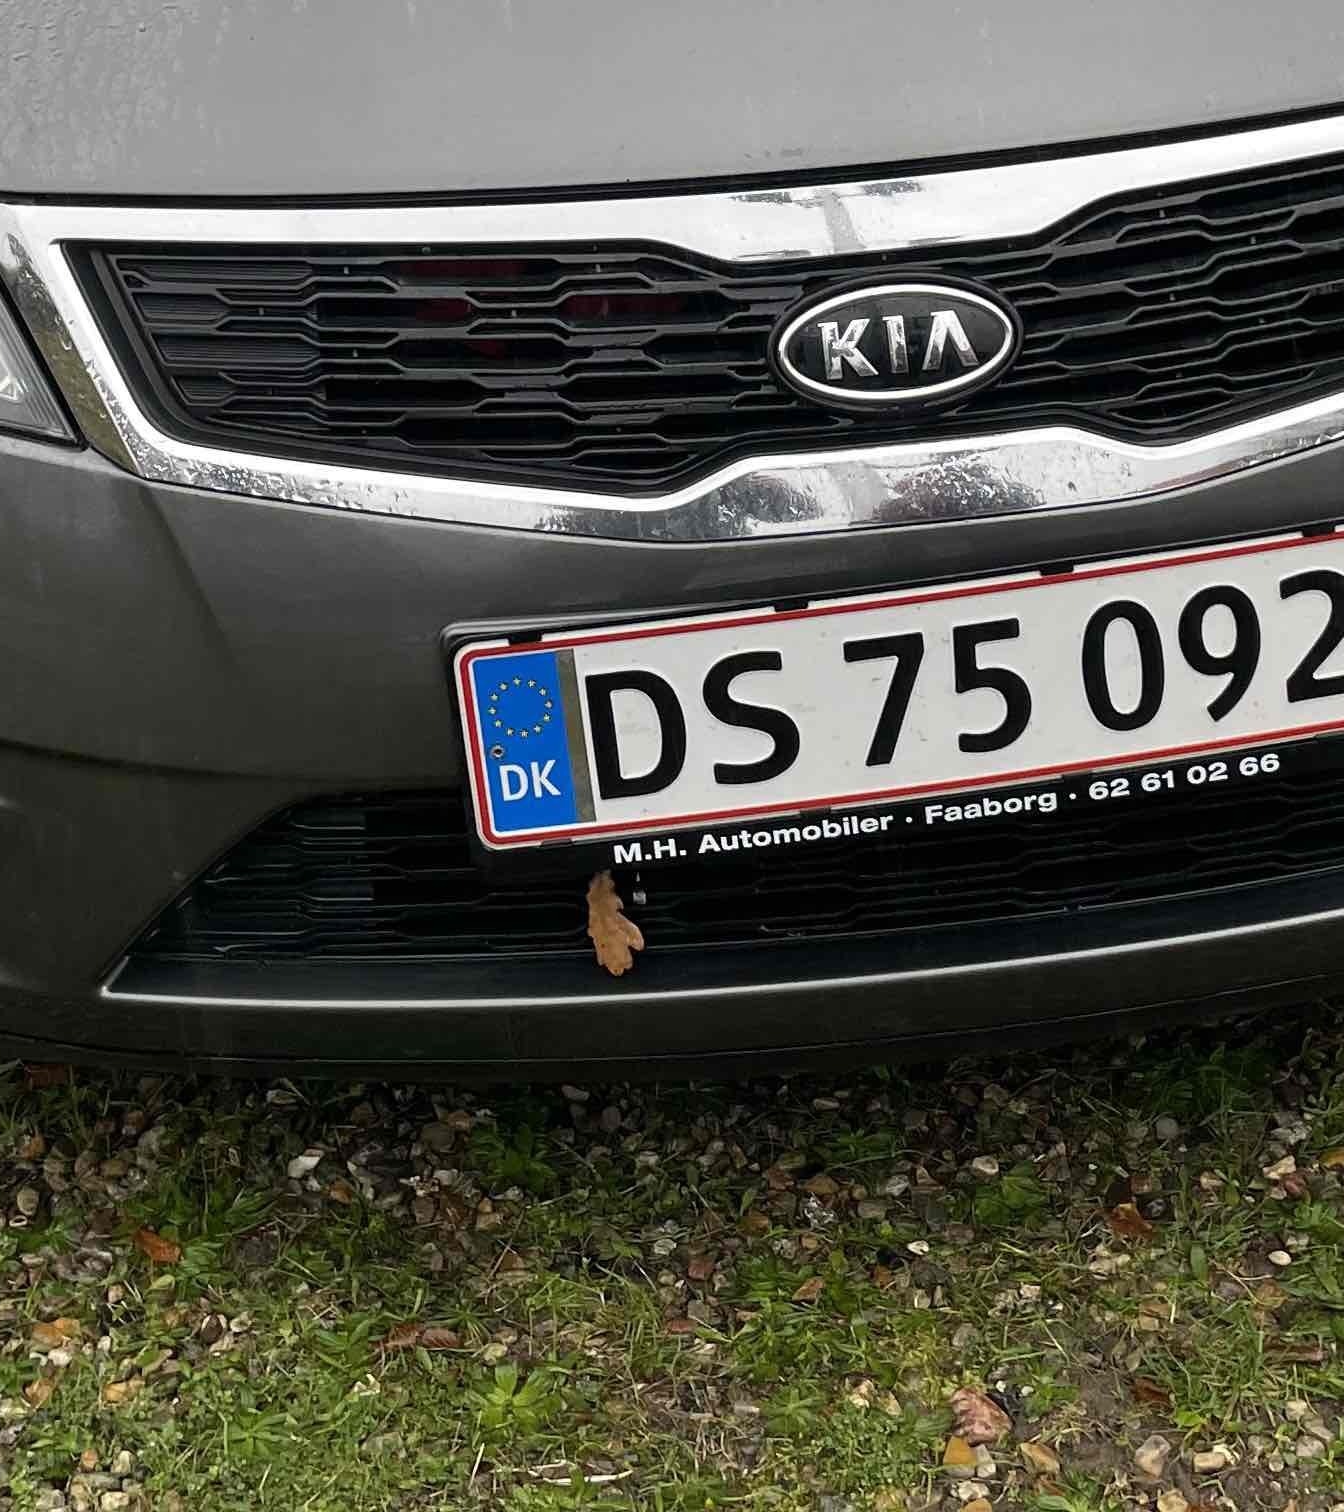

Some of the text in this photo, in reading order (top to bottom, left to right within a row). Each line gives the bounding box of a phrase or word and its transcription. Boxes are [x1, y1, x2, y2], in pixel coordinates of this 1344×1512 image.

[817, 309, 980, 381] KIA
[584, 649, 801, 800] DS
[842, 617, 1032, 767] 75
[499, 759, 561, 802] DK
[613, 753, 1280, 865] M.H. Automobiler Faaborg 62 61 02 66
